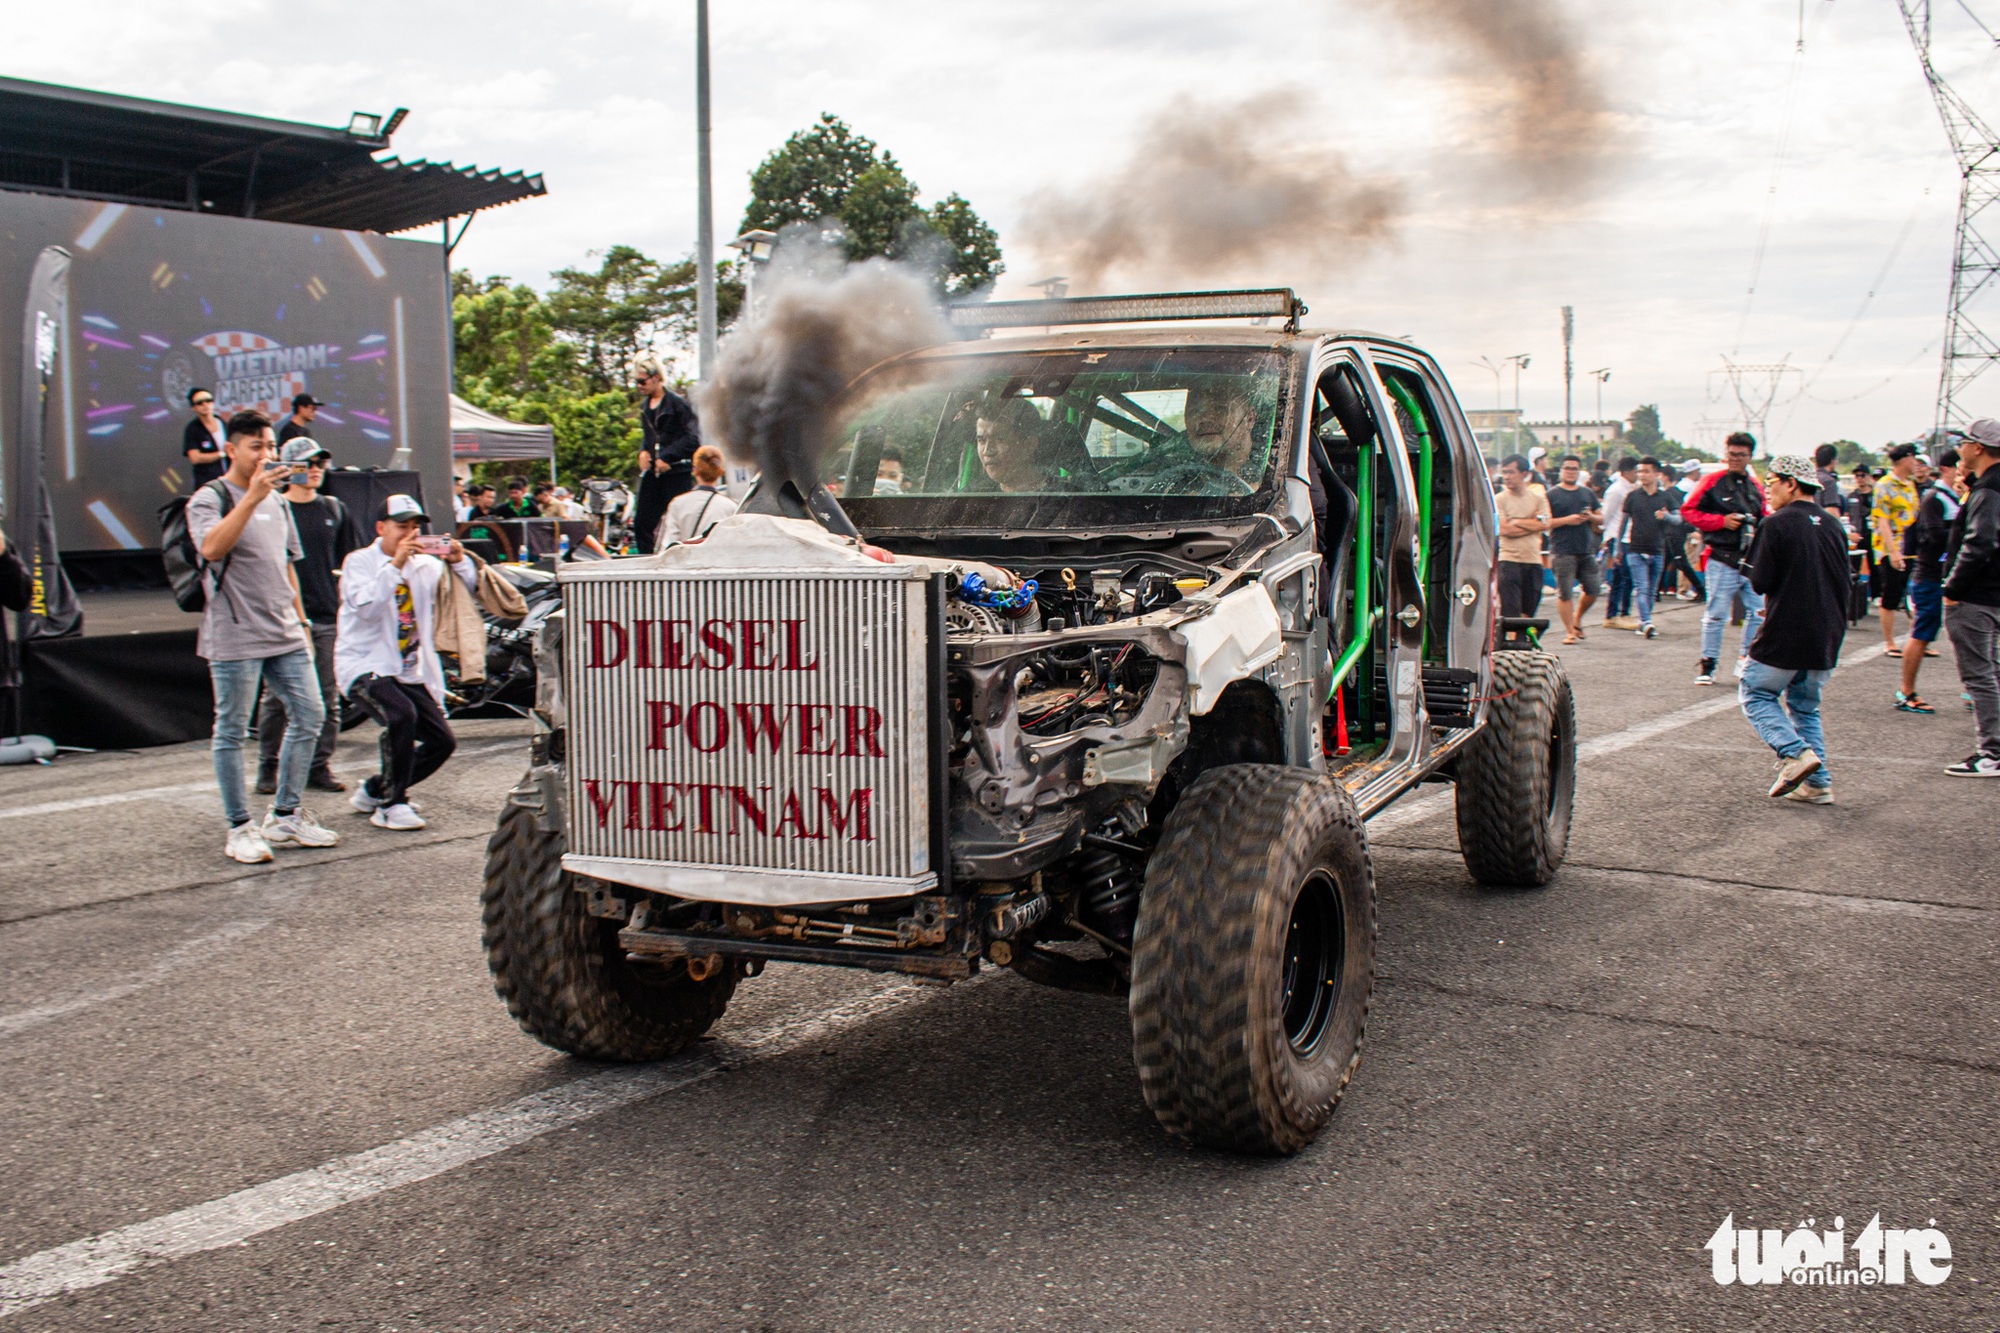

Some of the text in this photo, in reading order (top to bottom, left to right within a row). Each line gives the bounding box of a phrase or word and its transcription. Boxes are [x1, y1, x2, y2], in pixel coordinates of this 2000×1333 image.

[216, 344, 327, 377] VIETNAM
[218, 376, 283, 406] CARFEST
[584, 618, 819, 672] DIESEL
[644, 700, 887, 759] POWER
[580, 778, 875, 842] VIETNAM
